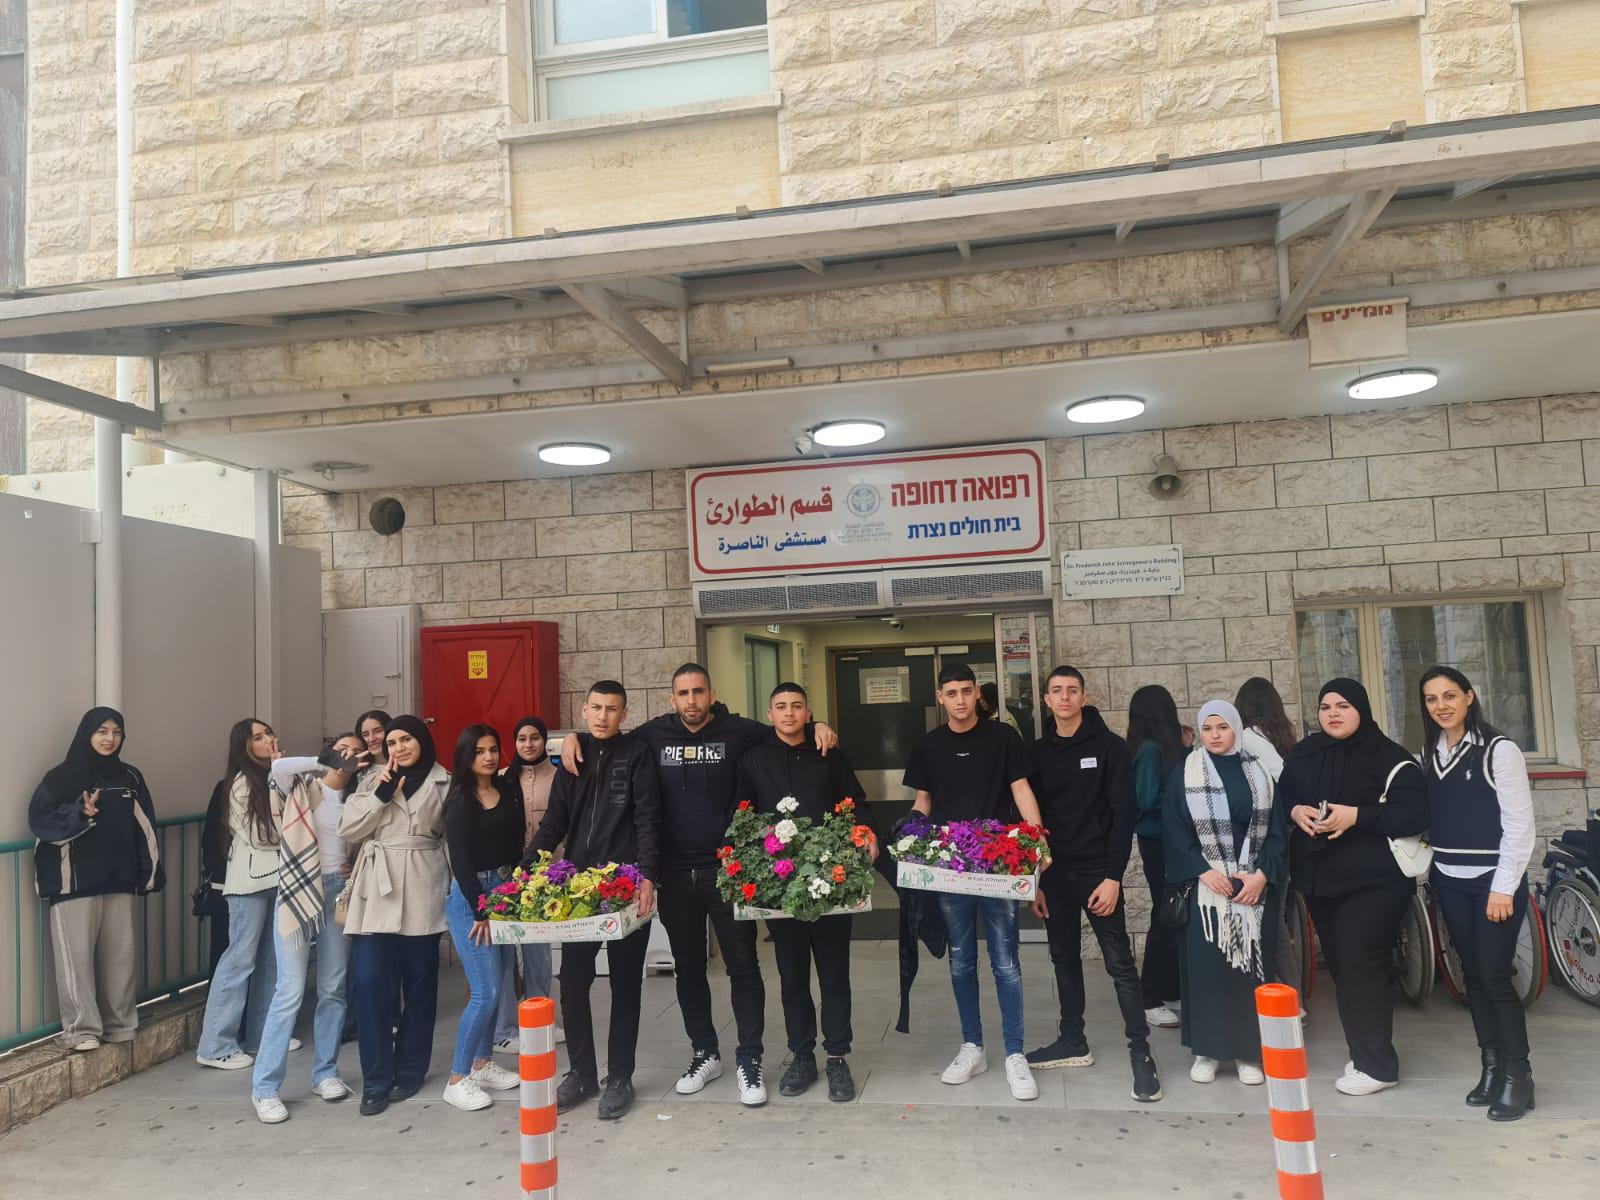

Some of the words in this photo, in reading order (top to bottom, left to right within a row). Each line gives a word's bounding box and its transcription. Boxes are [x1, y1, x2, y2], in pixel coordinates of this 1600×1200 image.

[891, 479, 958, 508] דחופה
[962, 474, 1031, 503] רפואה
[705, 495, 786, 526] الطوارئ
[789, 486, 833, 521] قسم
[907, 521, 946, 539] נצרת
[949, 515, 991, 537] חולים
[994, 516, 1022, 533] בית
[718, 536, 770, 555] الناصرة
[774, 533, 828, 552] مستشفى
